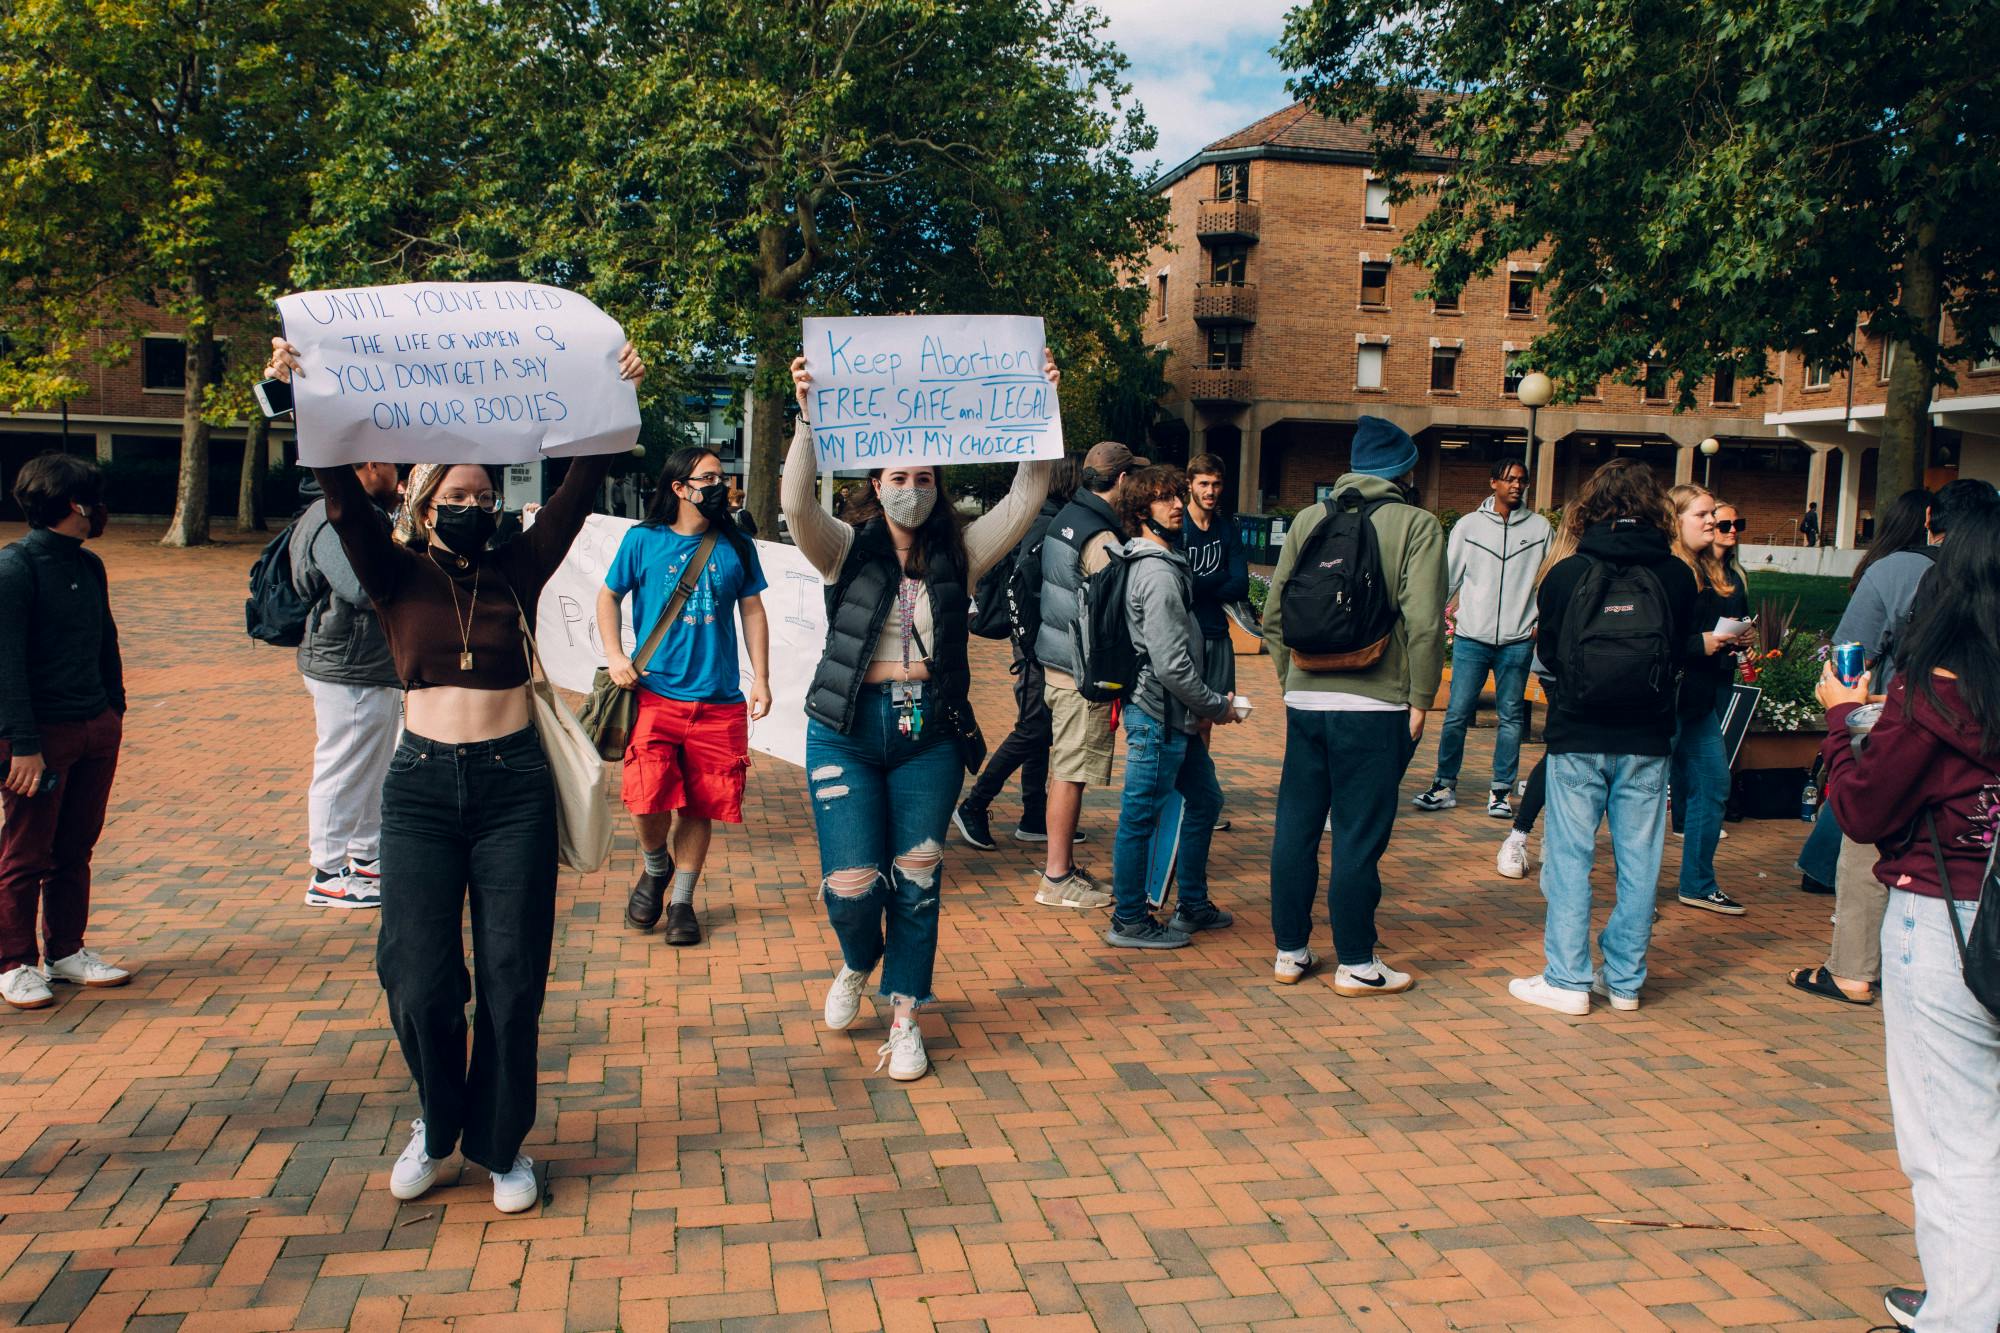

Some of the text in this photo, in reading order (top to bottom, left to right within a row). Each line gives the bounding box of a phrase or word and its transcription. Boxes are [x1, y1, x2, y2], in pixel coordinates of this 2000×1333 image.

[301, 292, 395, 325] UNTIL
[496, 289, 562, 313] LIVED
[342, 331, 521, 356] THE LIFE OF WOMEN
[828, 331, 1035, 385] Keep Abortion
[325, 357, 547, 395] YOU DONT GET A SAY
[373, 392, 568, 431] ON OUR BODIES
[896, 387, 957, 424] SAFE
[959, 398, 983, 420] and
[991, 386, 1053, 422] LEGAL
[818, 430, 1036, 463] MY BODY! MY CHOICE!
